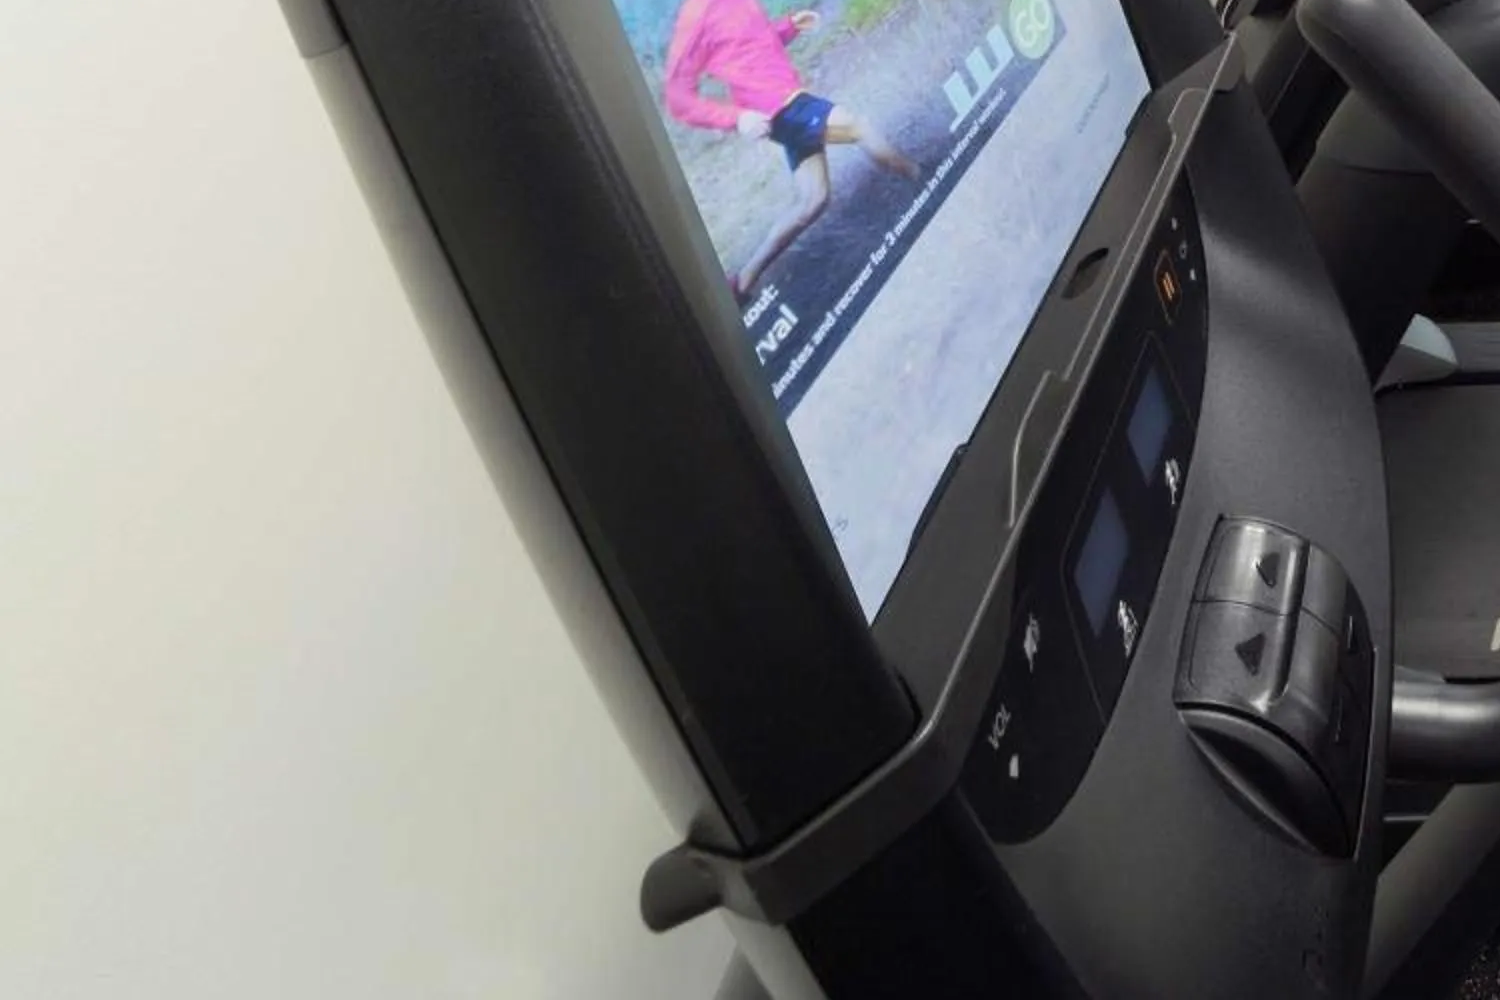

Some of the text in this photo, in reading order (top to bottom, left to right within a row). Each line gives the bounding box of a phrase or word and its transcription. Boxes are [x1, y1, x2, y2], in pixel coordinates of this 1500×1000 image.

[811, 310, 837, 346] and
[870, 243, 889, 266] for
[988, 703, 1012, 751] VOL
